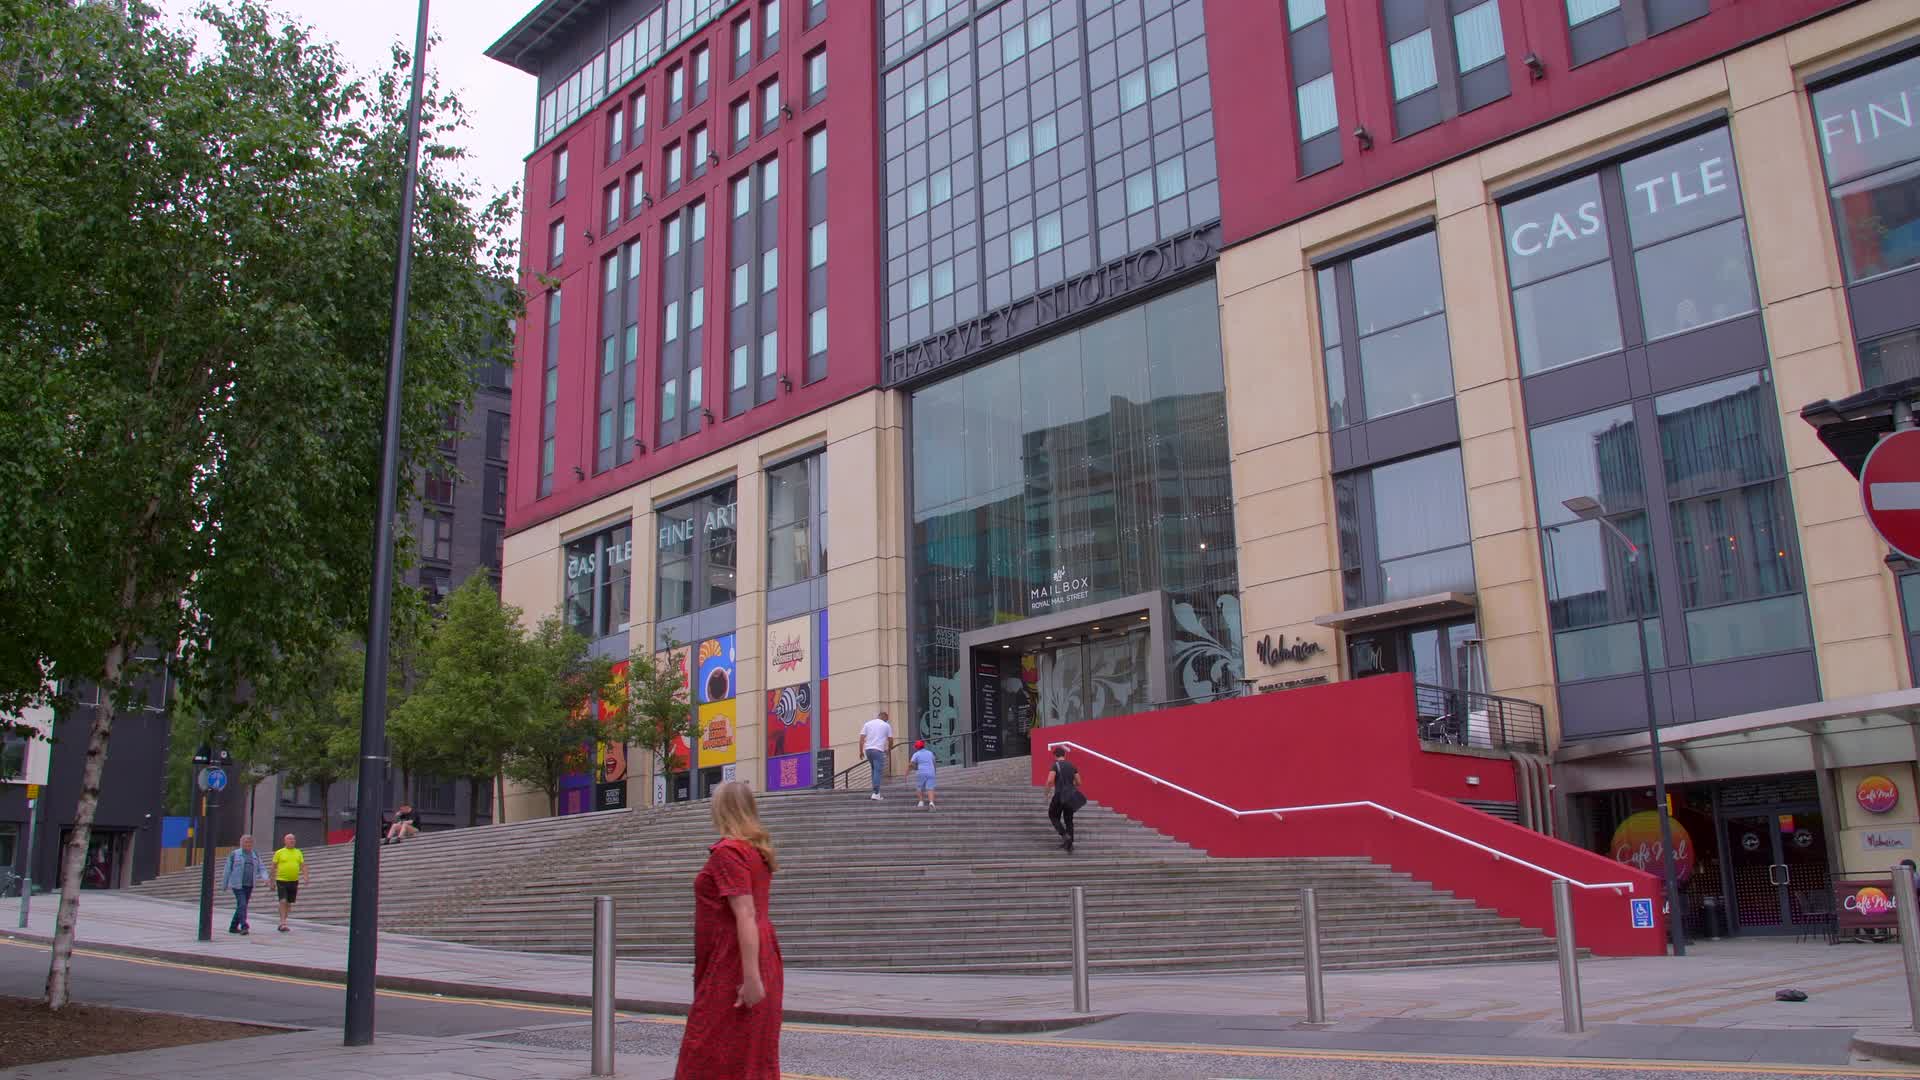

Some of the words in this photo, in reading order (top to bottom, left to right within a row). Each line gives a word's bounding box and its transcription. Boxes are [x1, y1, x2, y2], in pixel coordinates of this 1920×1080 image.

[1820, 88, 1920, 155] FIN
[890, 303, 1017, 383] HARVEY
[1034, 229, 1210, 326] NICHOLS
[659, 518, 694, 549] FINE
[703, 503, 737, 533] ART
[1031, 577, 1088, 600] MAILBOX
[1031, 600, 1050, 609] ROYAL
[1051, 597, 1065, 605] MAIL
[1066, 591, 1089, 602] STREET
[1257, 634, 1326, 667] Malmaison
[932, 686, 942, 763] AILBOX
[1616, 842, 1650, 870] Café
[1844, 895, 1871, 915] Café
